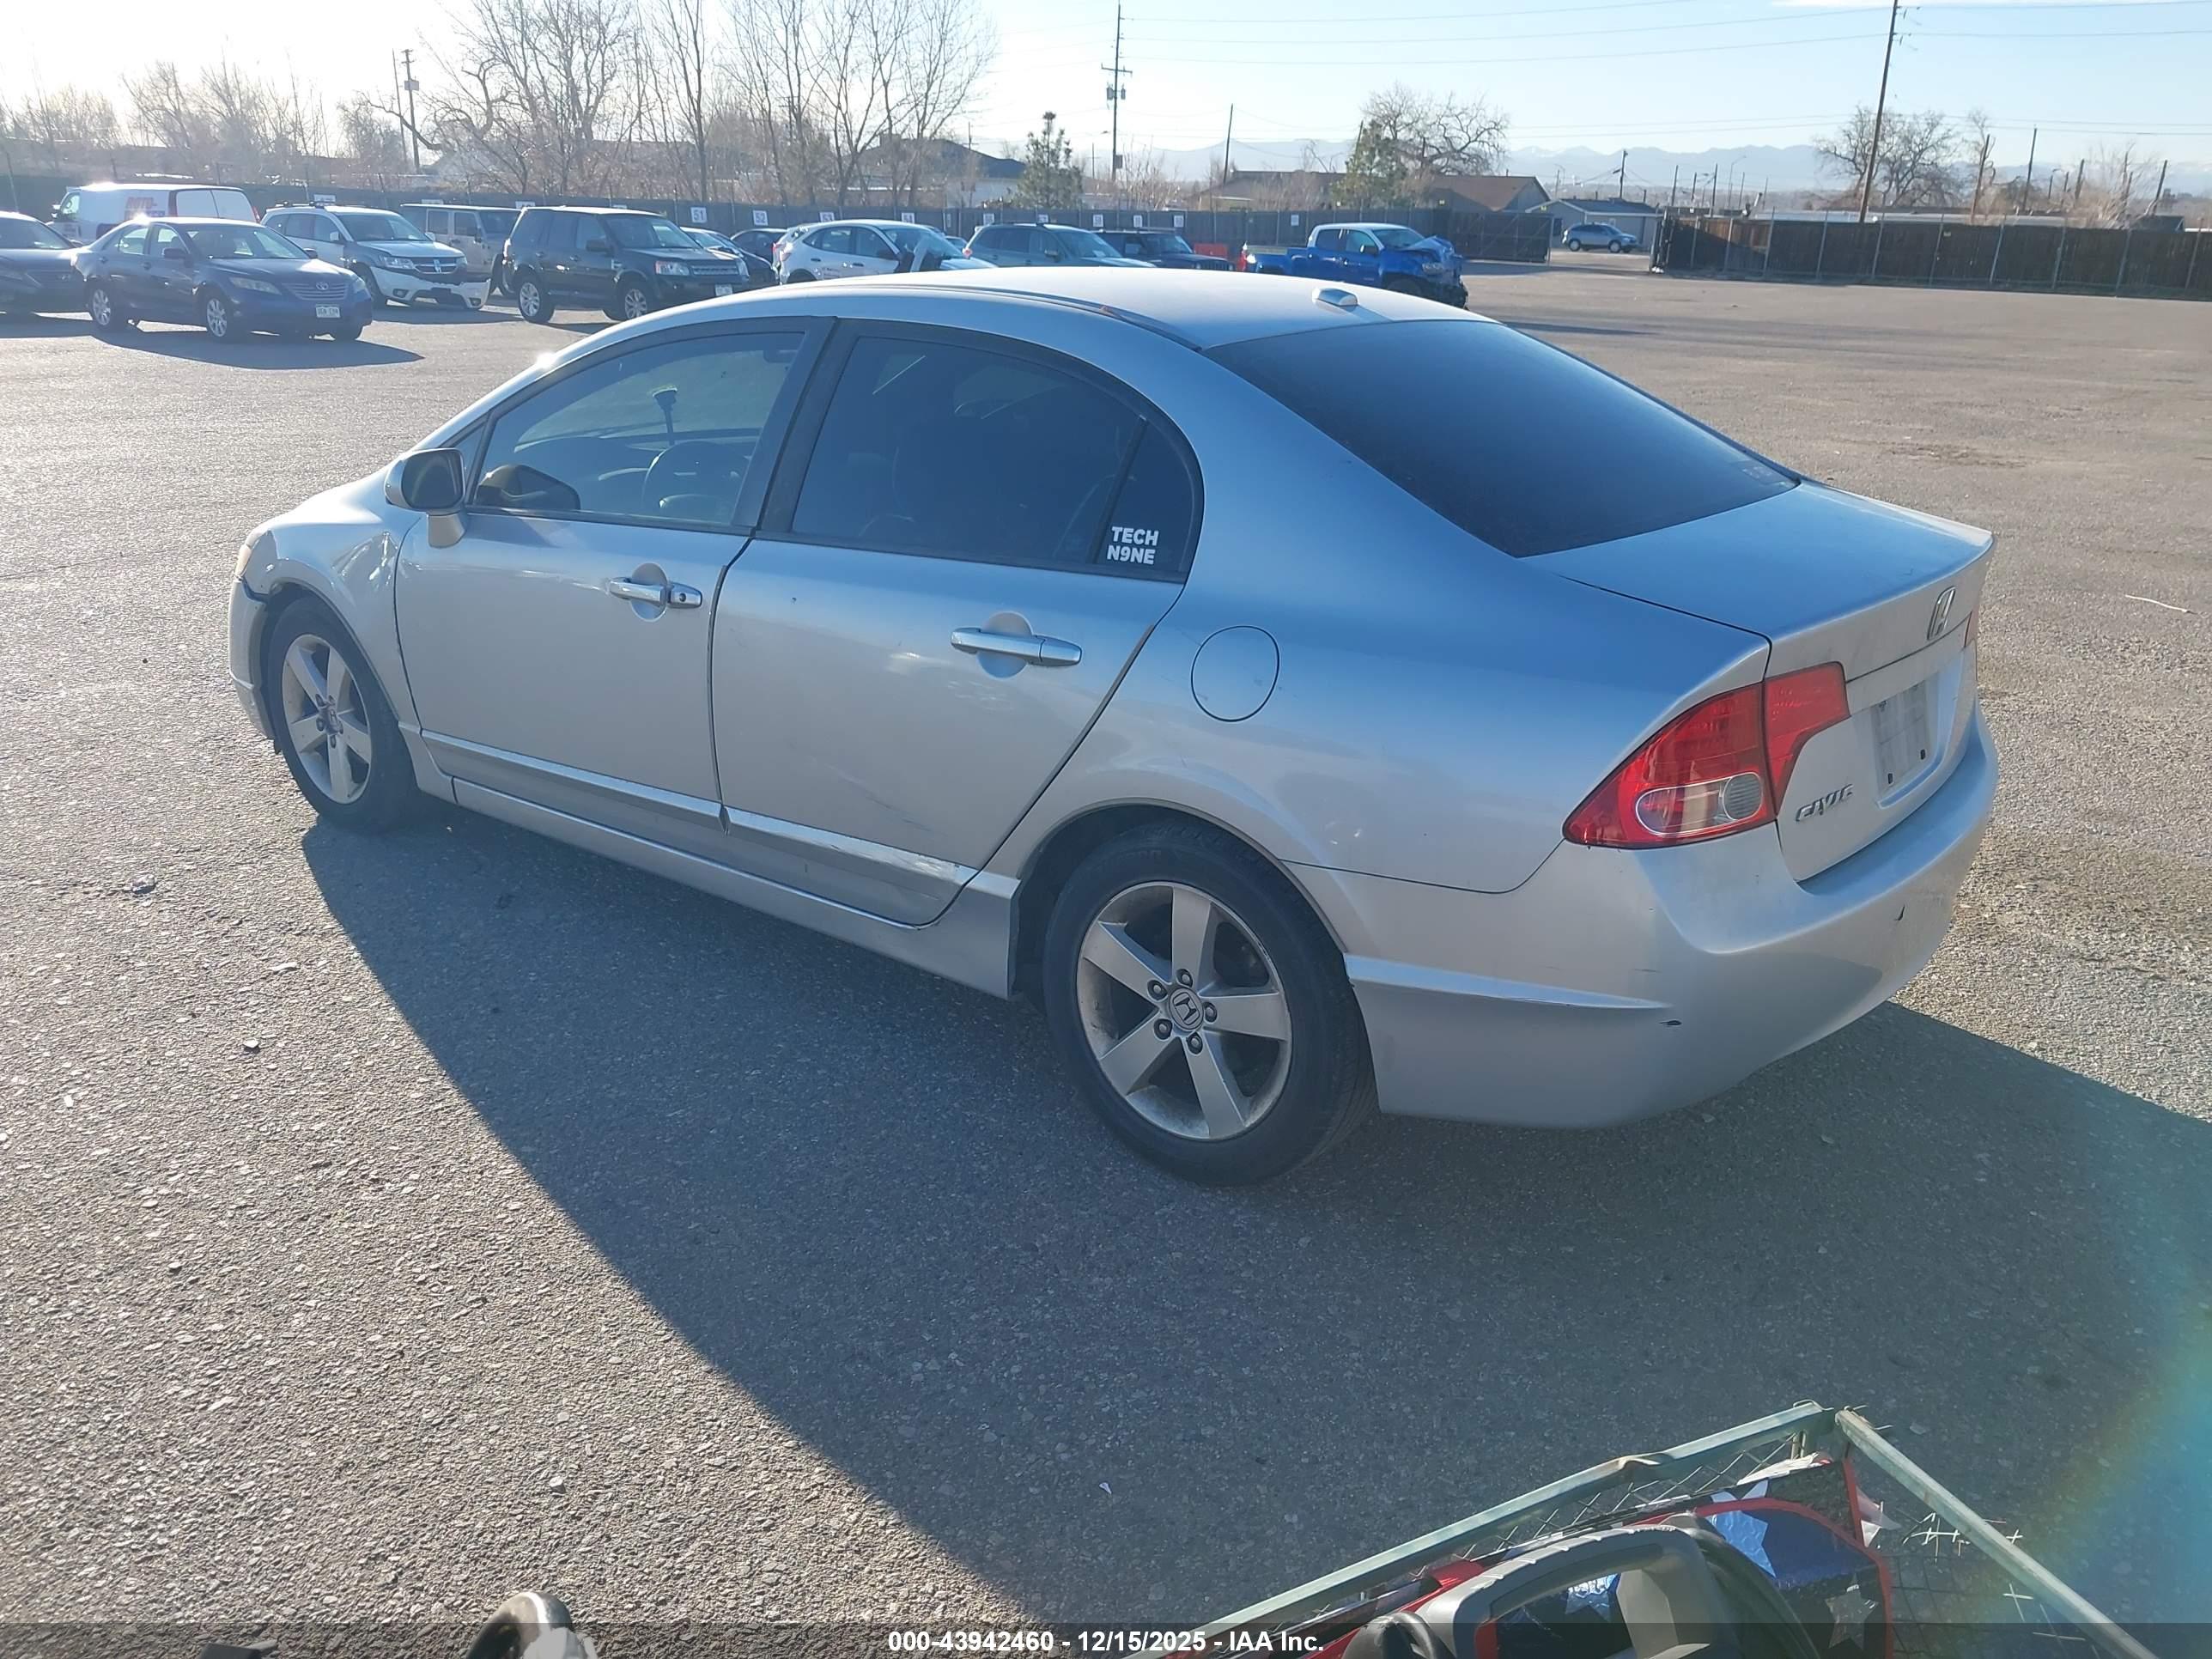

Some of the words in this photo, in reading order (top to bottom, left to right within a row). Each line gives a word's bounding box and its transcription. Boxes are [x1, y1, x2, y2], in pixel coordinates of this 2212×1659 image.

[693, 209, 704, 221] 51
[755, 212, 766, 223] 52
[1112, 526, 1159, 546] TECH
[1107, 544, 1156, 565] N9NE
[1796, 783, 1853, 822] CIVIC
